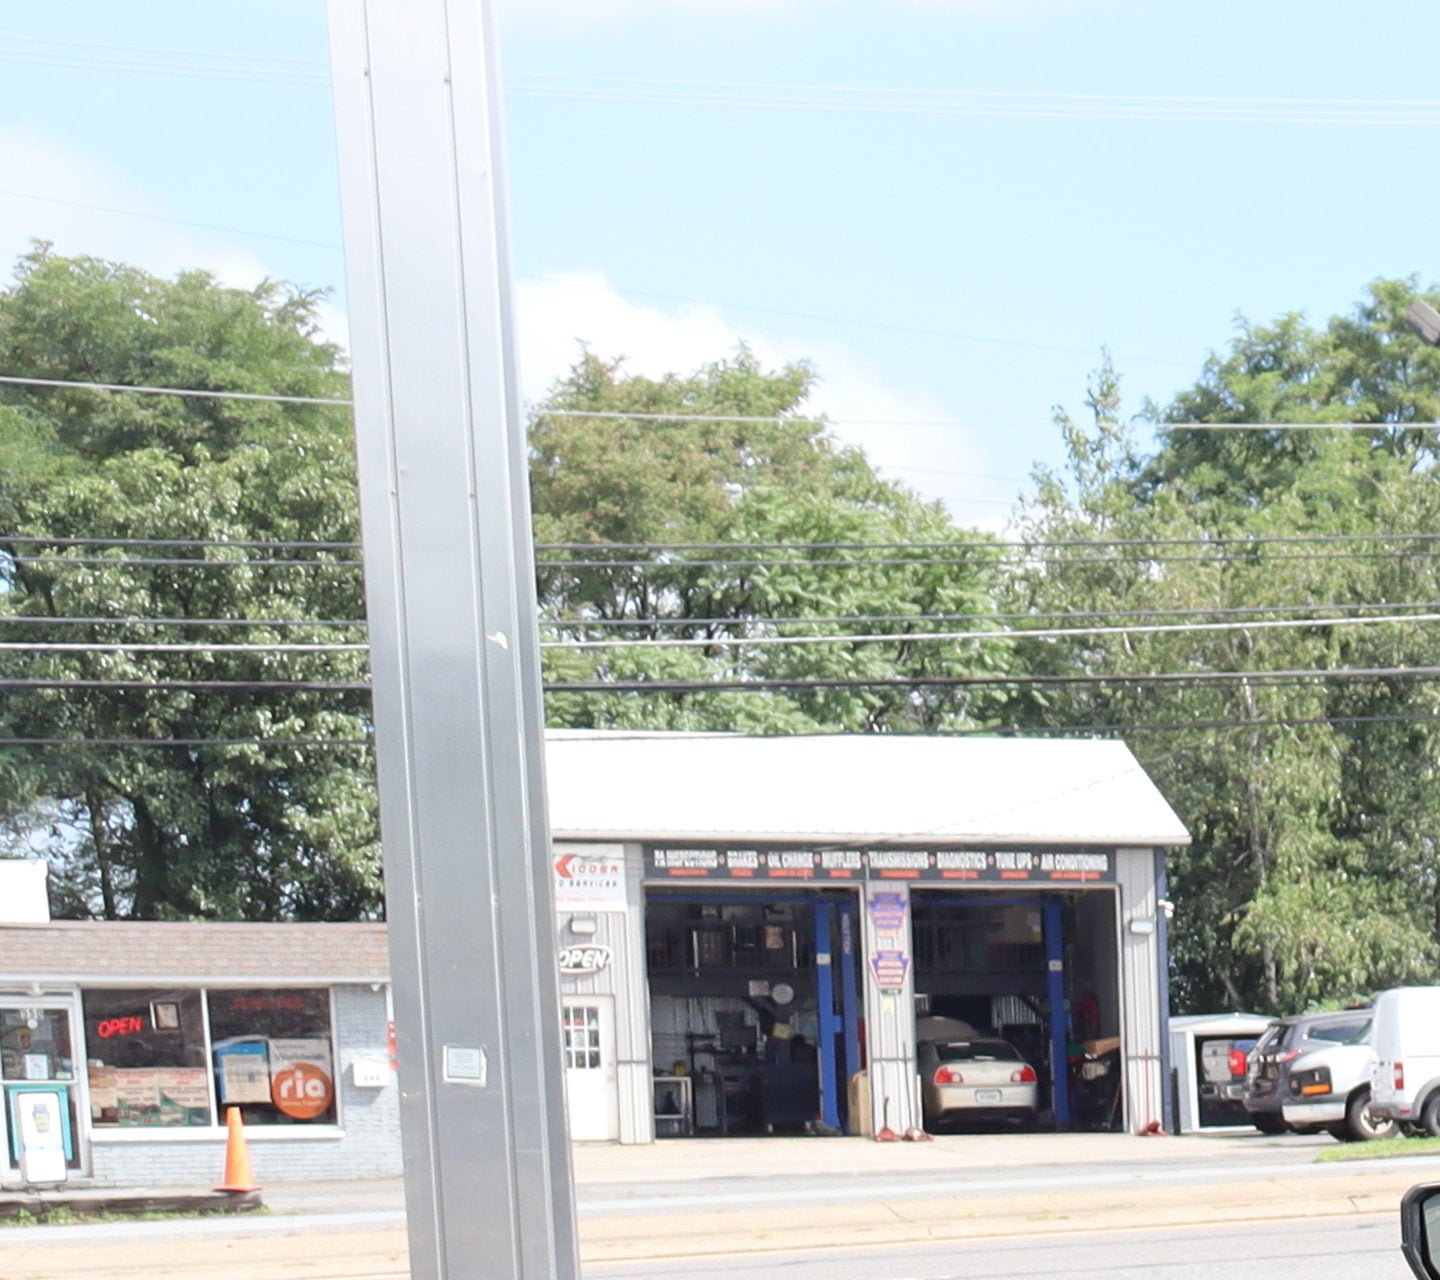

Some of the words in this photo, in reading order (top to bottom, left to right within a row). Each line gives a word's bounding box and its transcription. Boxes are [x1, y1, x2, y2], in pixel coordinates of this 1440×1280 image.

[559, 950, 608, 969] OPEN
[98, 1016, 143, 1038] OPEN
[280, 1069, 327, 1099] ria
